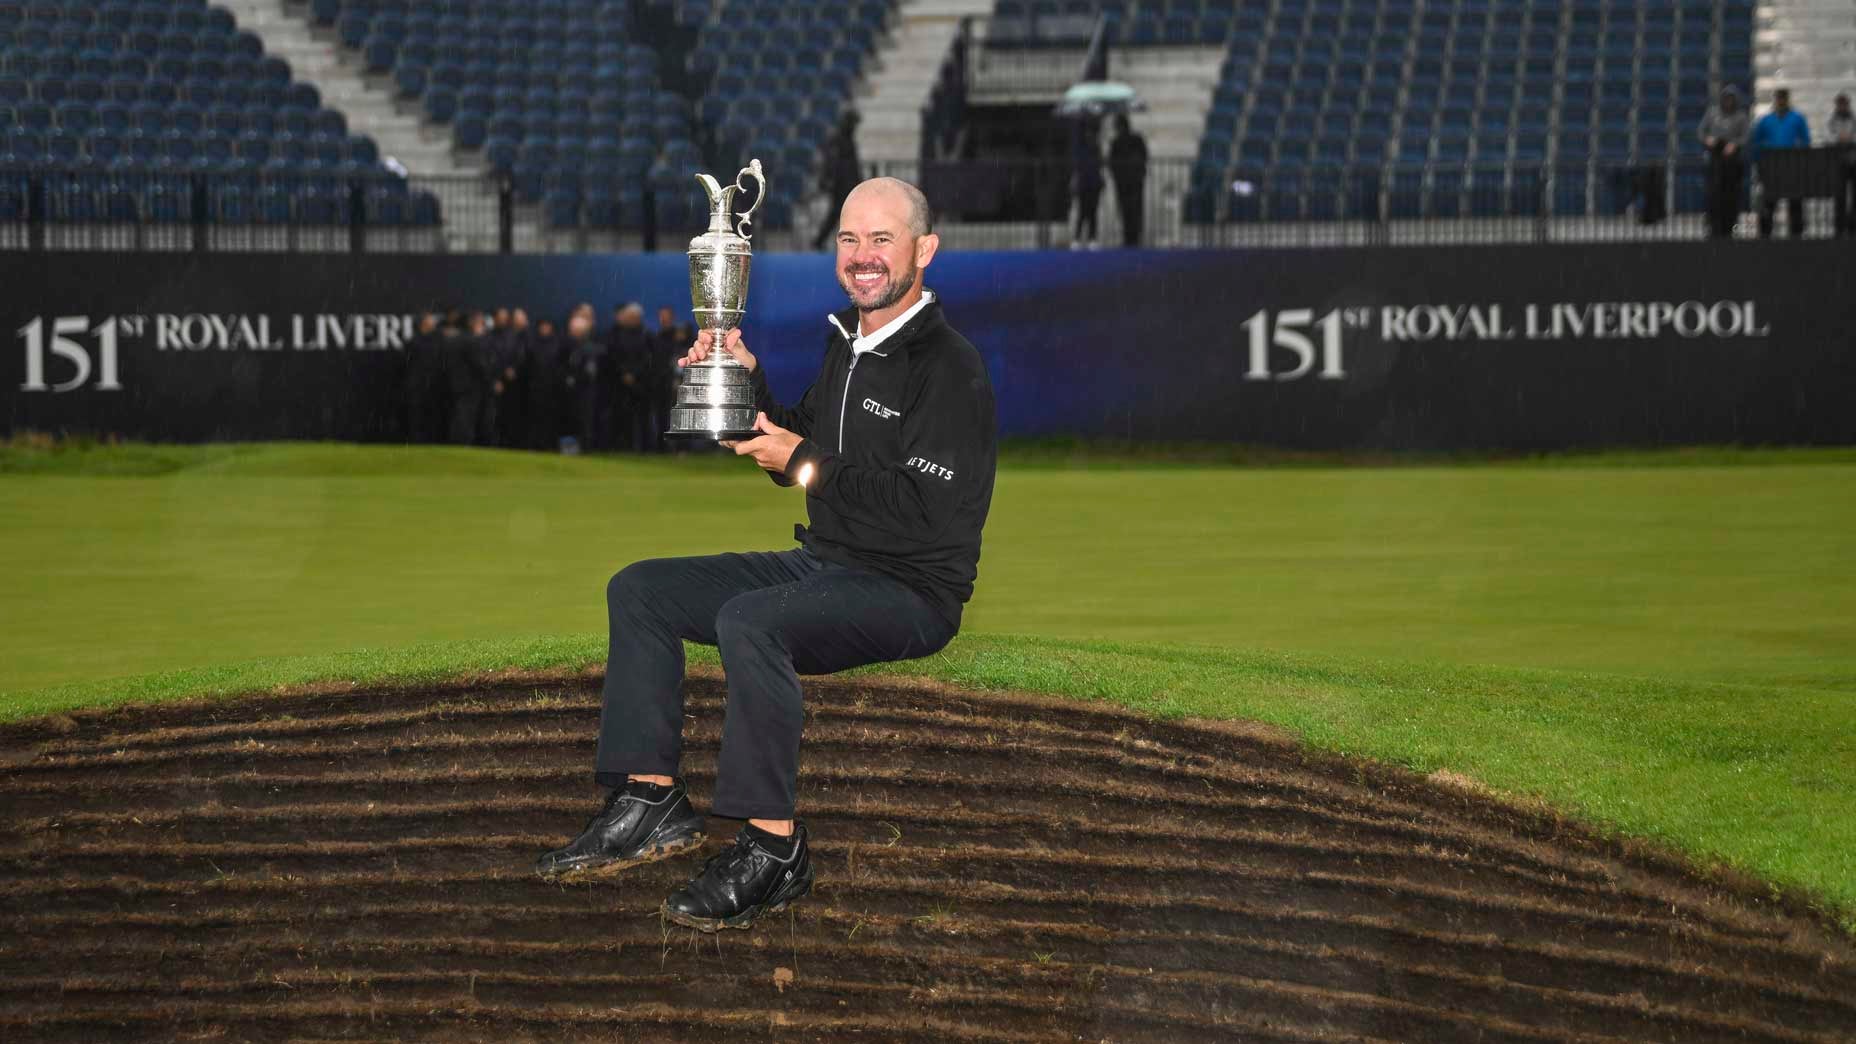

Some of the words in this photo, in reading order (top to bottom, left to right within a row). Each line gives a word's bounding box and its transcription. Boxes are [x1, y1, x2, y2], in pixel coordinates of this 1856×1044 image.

[156, 313, 283, 351] ROYAL
[292, 313, 415, 351] LIVER
[1381, 303, 1515, 342] ROYAL
[1526, 300, 1770, 340] LIVERPOOL
[863, 398, 881, 416] GTL
